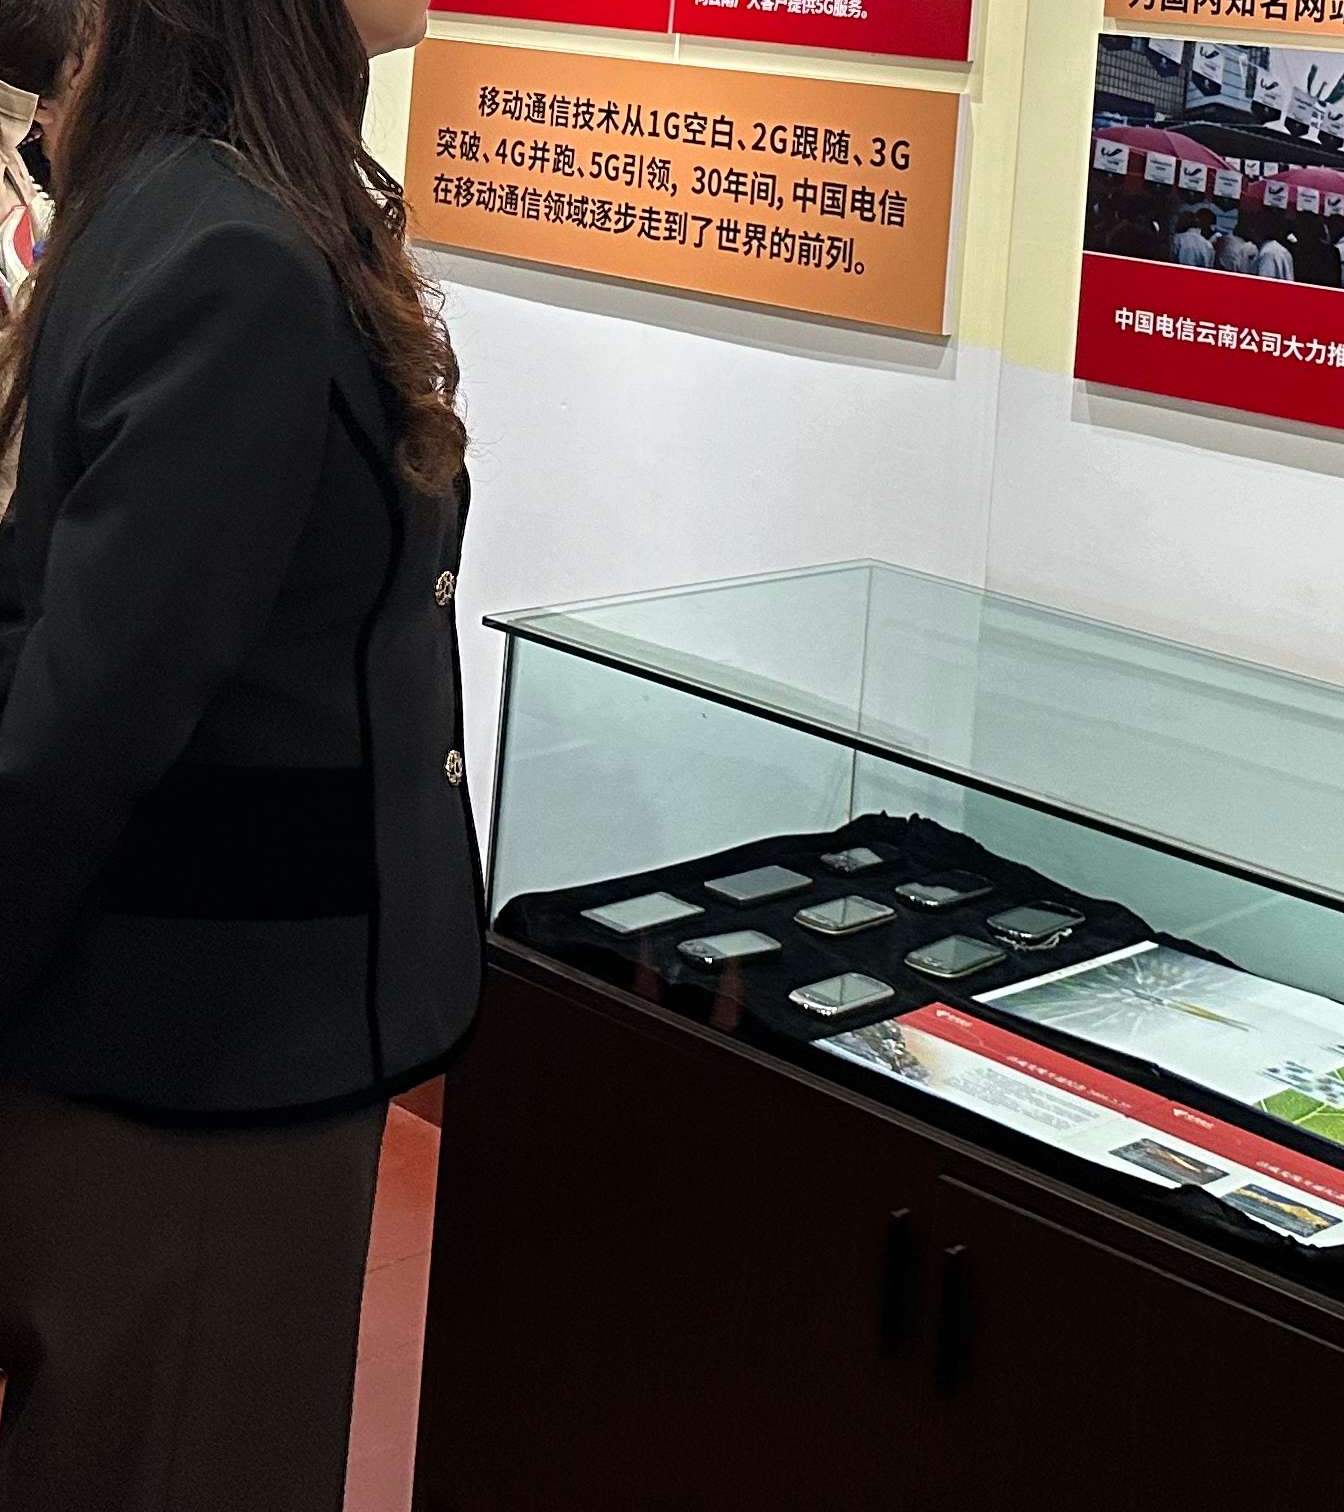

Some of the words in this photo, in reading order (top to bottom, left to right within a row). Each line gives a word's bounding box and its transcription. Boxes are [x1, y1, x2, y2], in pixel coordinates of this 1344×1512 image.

[433, 173, 866, 276] 在移动通信领域逐步走到了世界的前列。
